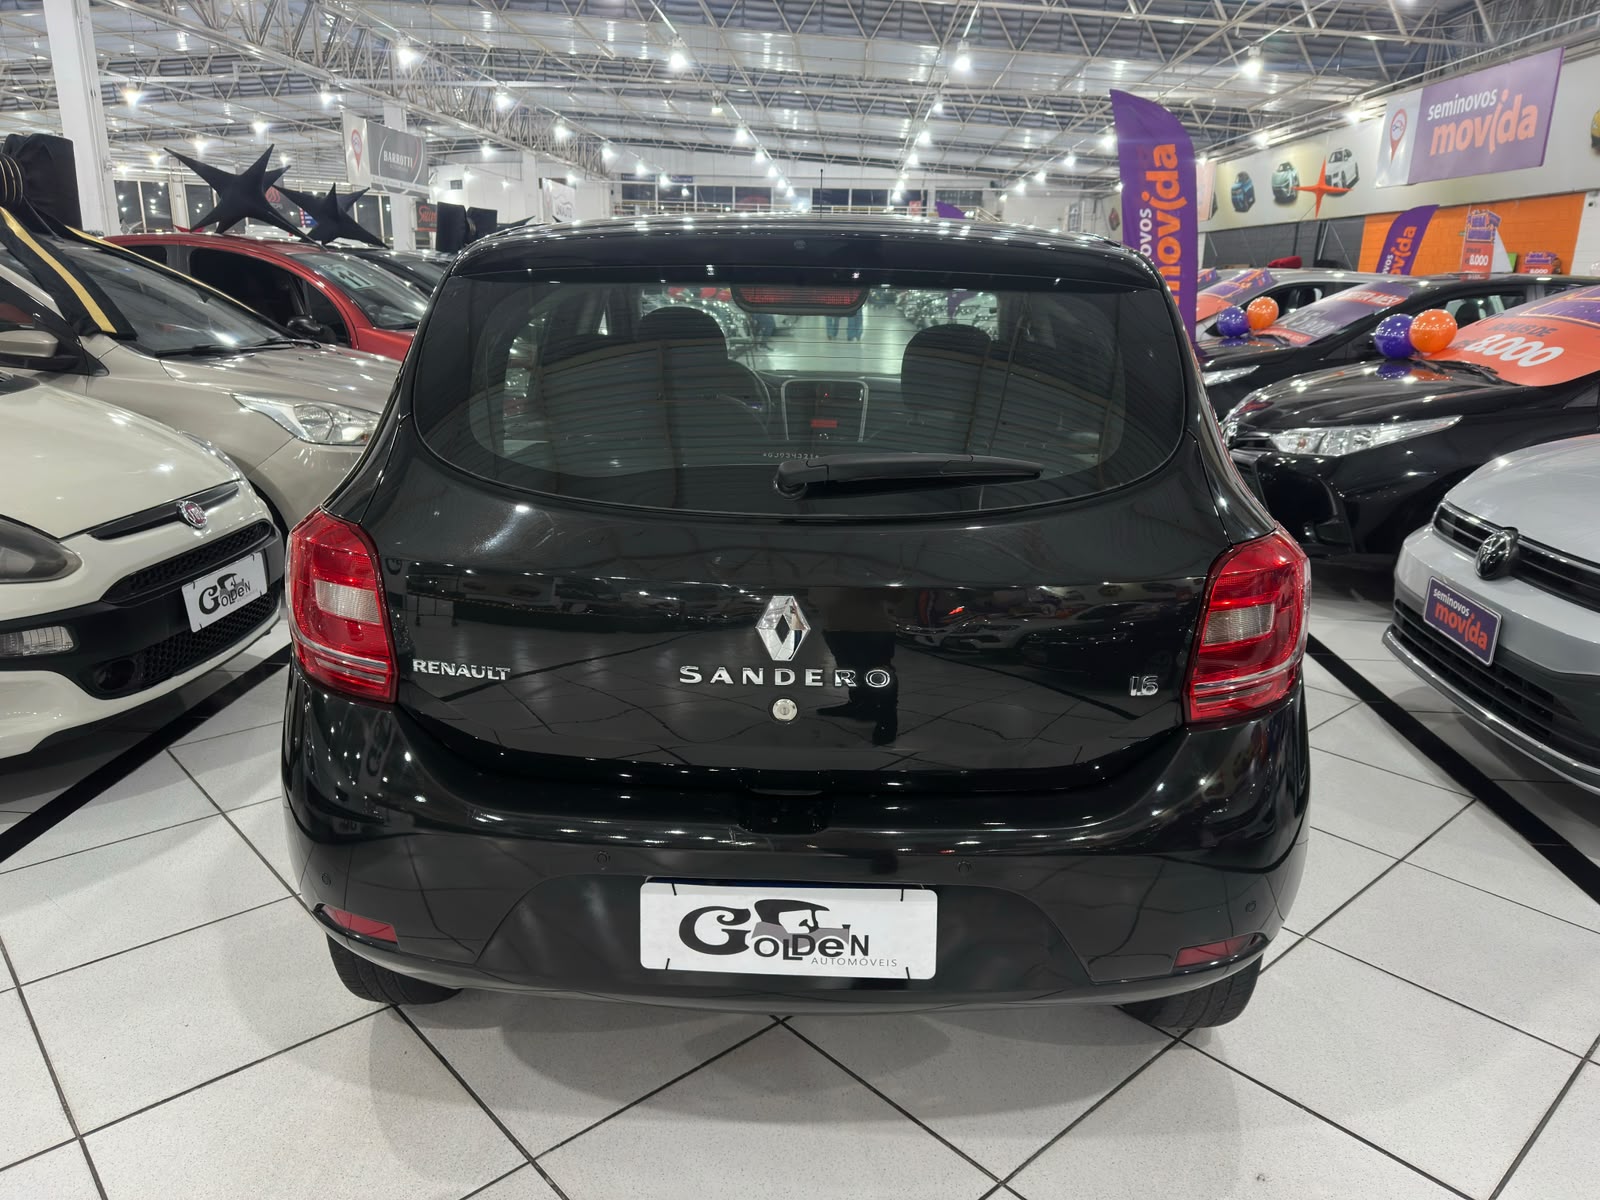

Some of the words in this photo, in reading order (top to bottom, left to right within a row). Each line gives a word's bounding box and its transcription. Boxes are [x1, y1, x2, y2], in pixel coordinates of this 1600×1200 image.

[1427, 88, 1498, 121] seminovos
[1429, 89, 1539, 157] movida
[1390, 226, 1417, 275] vida
[1464, 333, 1565, 368] 8.000
[1433, 588, 1470, 617] seminovos
[1434, 602, 1488, 651] movida
[412, 659, 511, 681] RENAULT
[679, 665, 891, 688] SANDERO
[811, 956, 898, 968] AUTOMÓVEIS
